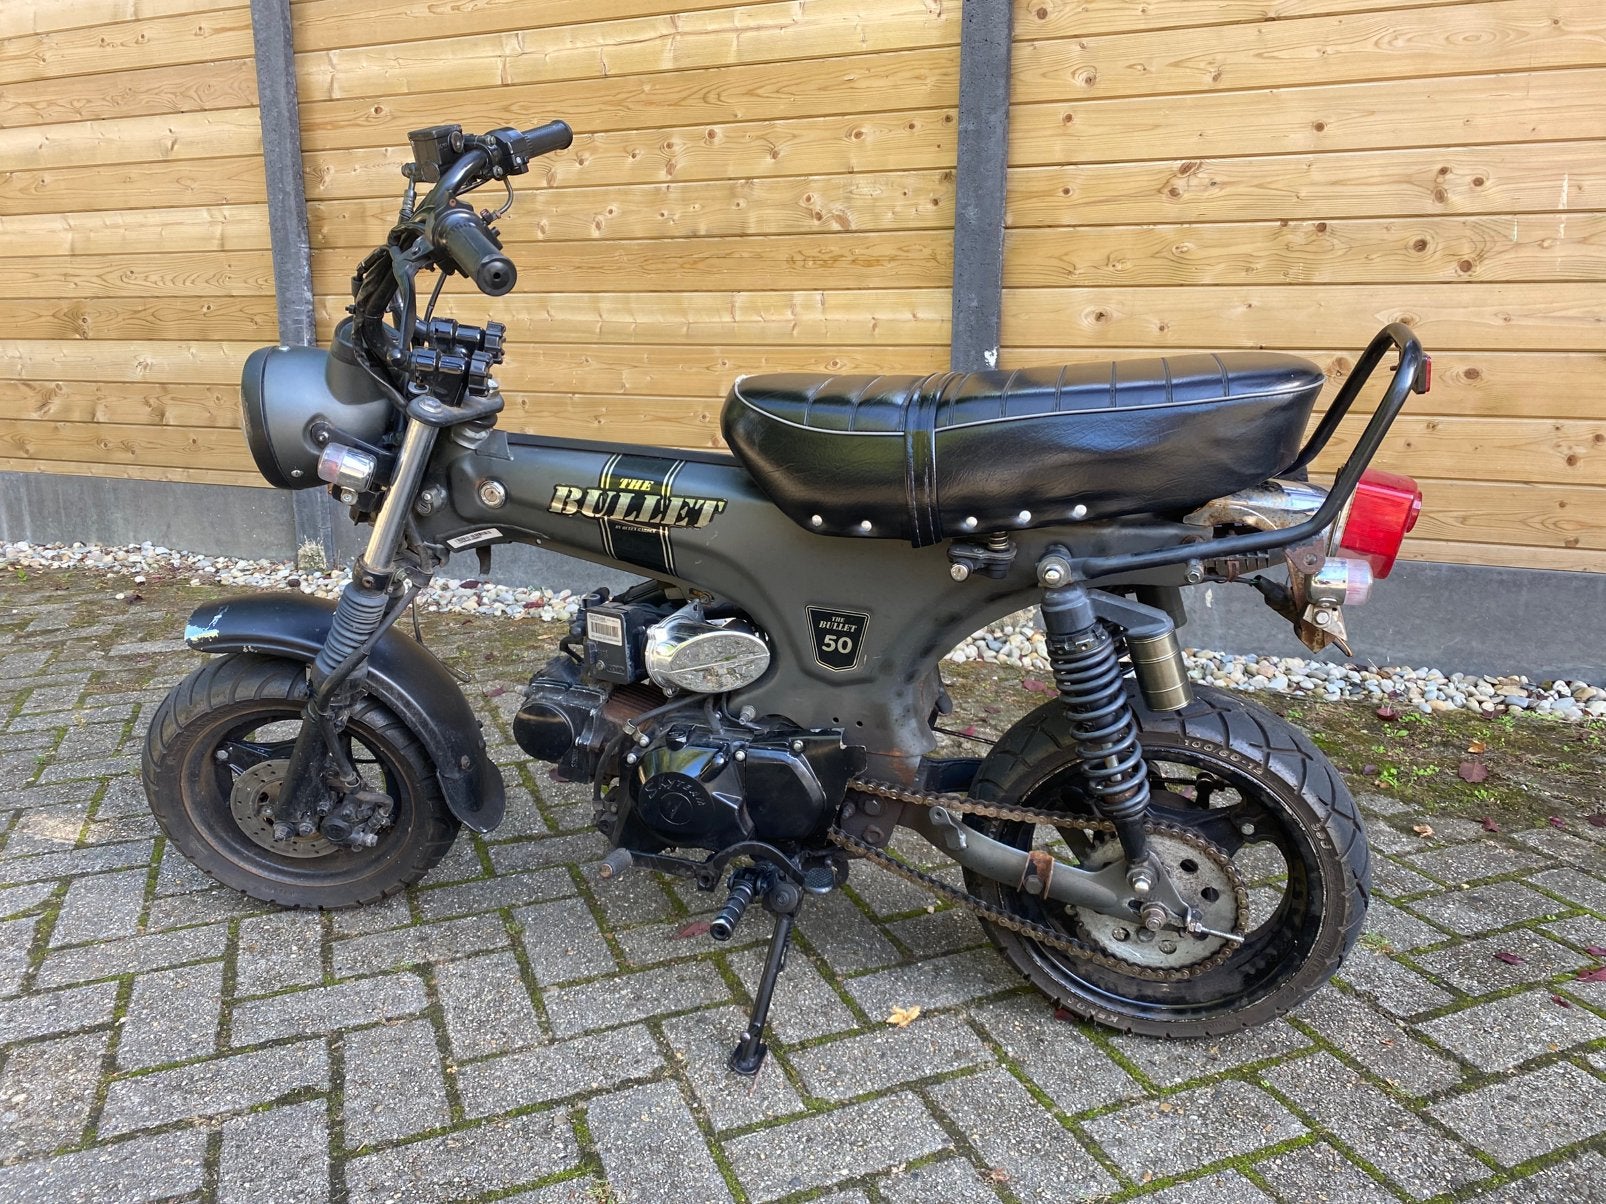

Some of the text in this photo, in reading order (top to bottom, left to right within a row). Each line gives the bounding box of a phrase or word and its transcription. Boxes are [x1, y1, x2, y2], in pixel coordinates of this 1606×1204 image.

[619, 478, 655, 491] THE
[548, 485, 728, 528] BULLET
[818, 620, 858, 633] BULLET
[821, 634, 853, 654] 50
